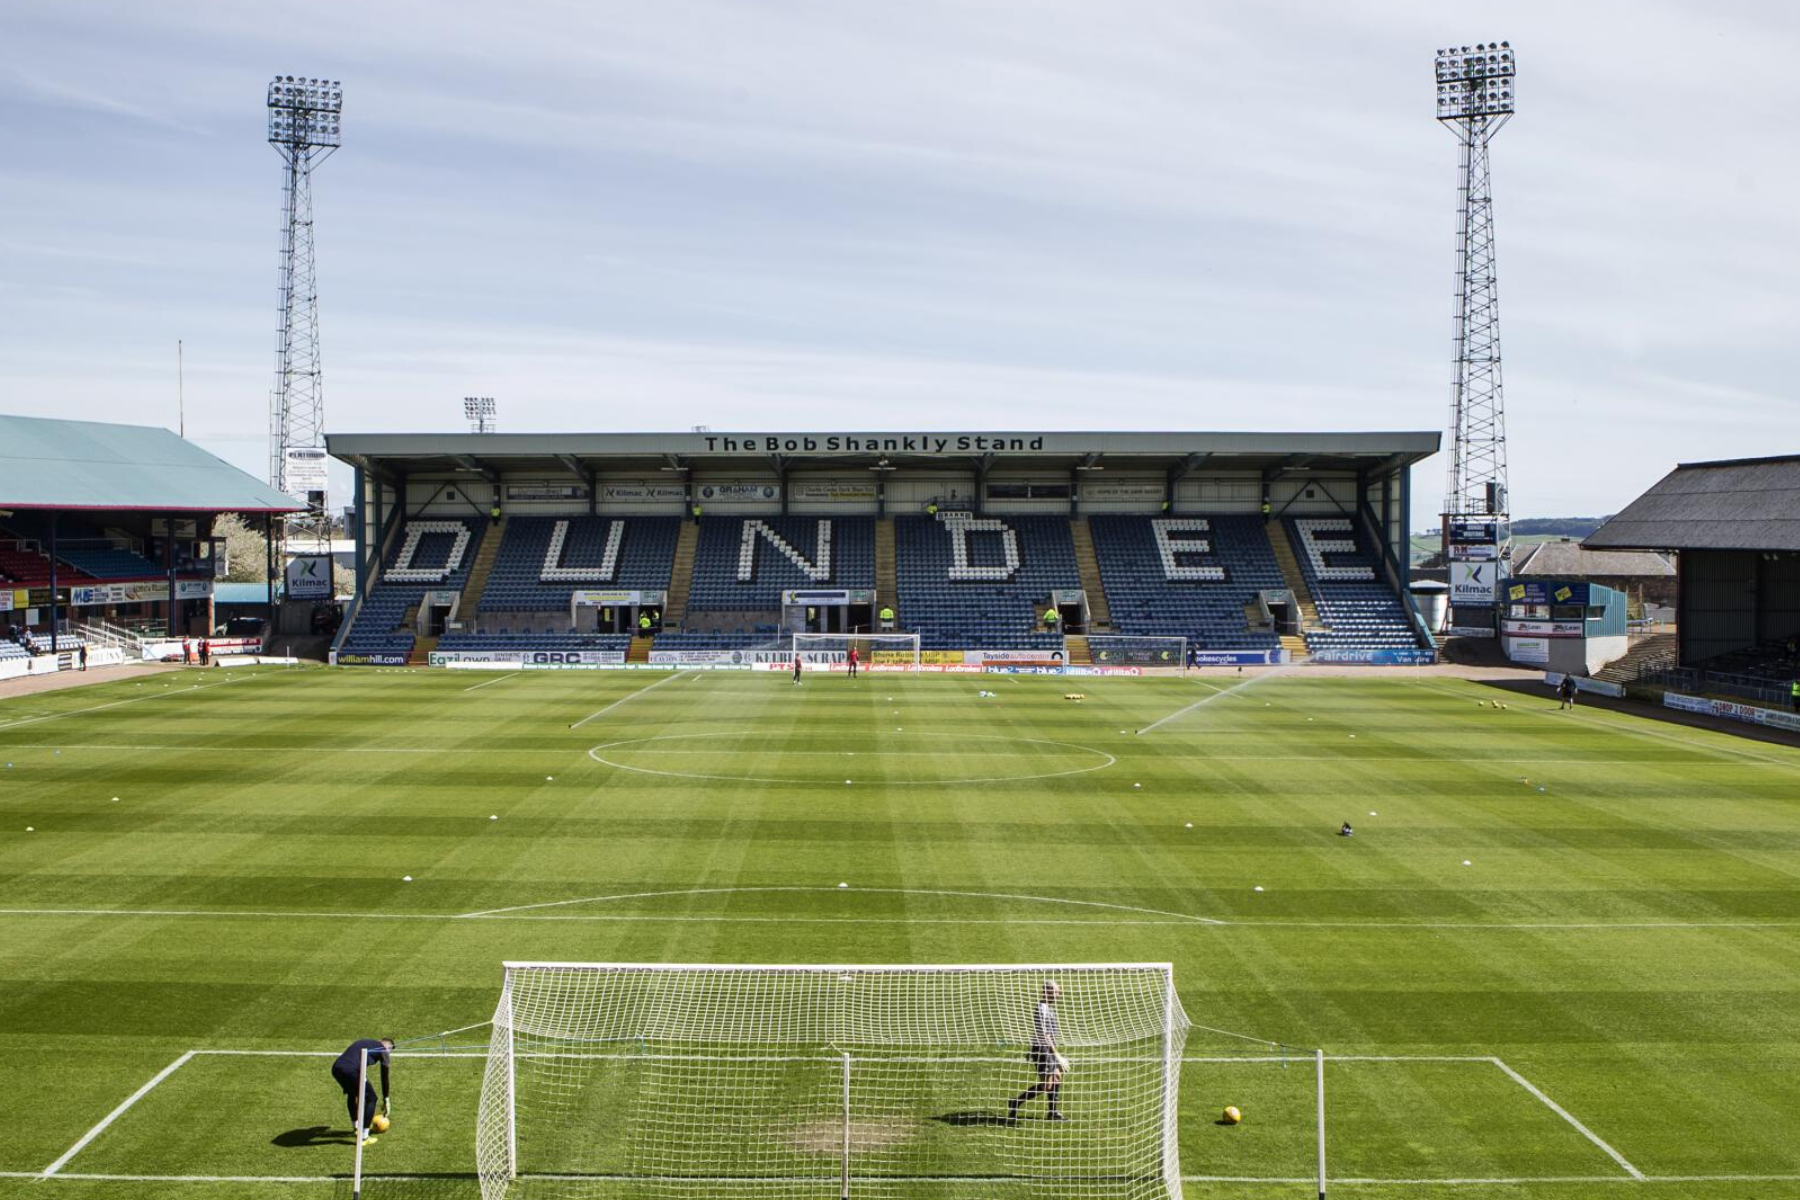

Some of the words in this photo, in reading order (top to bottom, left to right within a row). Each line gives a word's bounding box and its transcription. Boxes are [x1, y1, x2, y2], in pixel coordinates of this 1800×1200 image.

[705, 437, 757, 451] The
[766, 437, 817, 451] Bob
[827, 436, 947, 453] Shankly
[957, 436, 1043, 450] Stand
[657, 489, 684, 497] Kilmac
[292, 579, 327, 587] Kilmac
[1455, 585, 1492, 594] Kilmac
[338, 655, 404, 664] williamhill.com
[533, 653, 581, 664] GRC
[807, 652, 845, 663] SCRAP
[1316, 650, 1373, 662] Fairdrive
[869, 663, 905, 671] Ladbrokes
[945, 664, 982, 672] Ladbrokes
